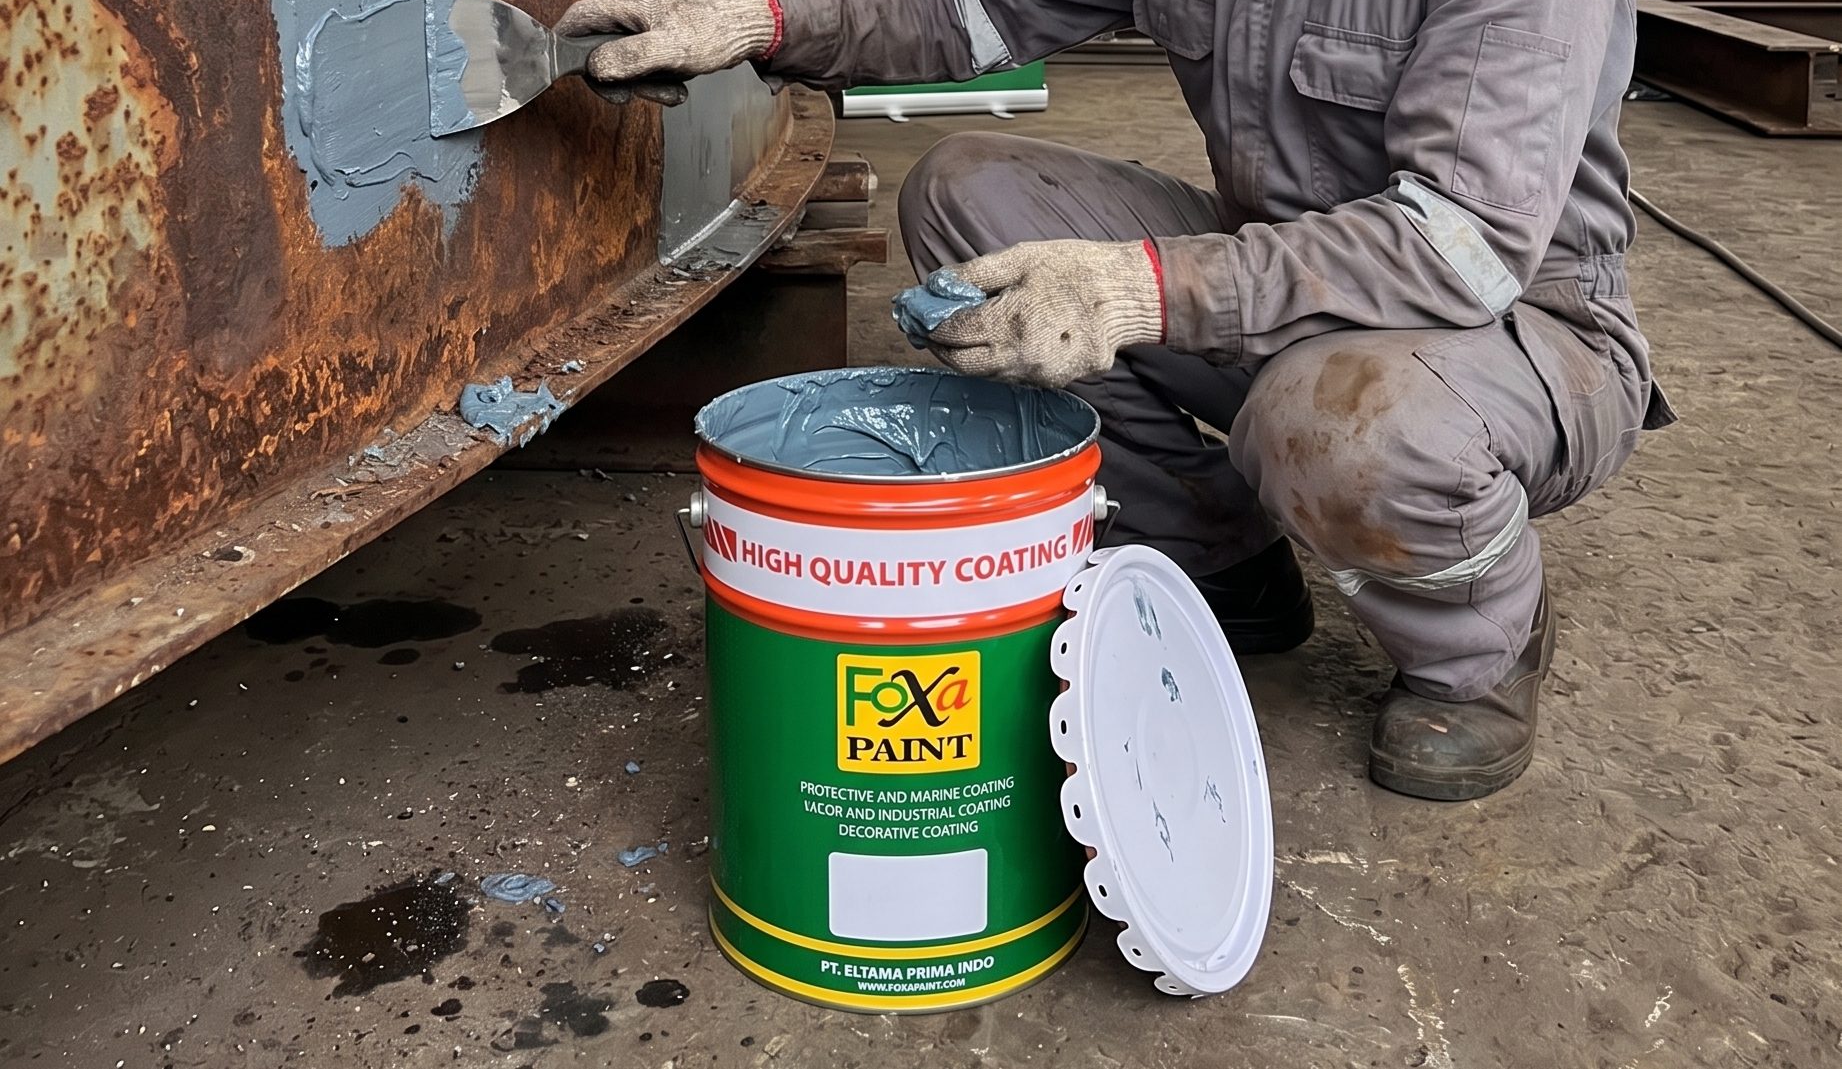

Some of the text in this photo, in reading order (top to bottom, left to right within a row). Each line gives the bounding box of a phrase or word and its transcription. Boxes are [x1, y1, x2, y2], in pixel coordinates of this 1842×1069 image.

[741, 534, 1067, 586] HIGH QUALITY COATING
[846, 734, 973, 762] PAINT
[800, 776, 1015, 803] PROTECTIVE AND MARINE COATING
[846, 807, 875, 820] AND
[878, 807, 955, 821] INDUSTRIAL
[958, 795, 1011, 816] COATING
[839, 821, 979, 839] DECORATIVE COATING
[821, 956, 995, 980] PT. ELTAMA PRIMA INDO
[857, 978, 966, 992] WWW.FOXAPAINT.COM
